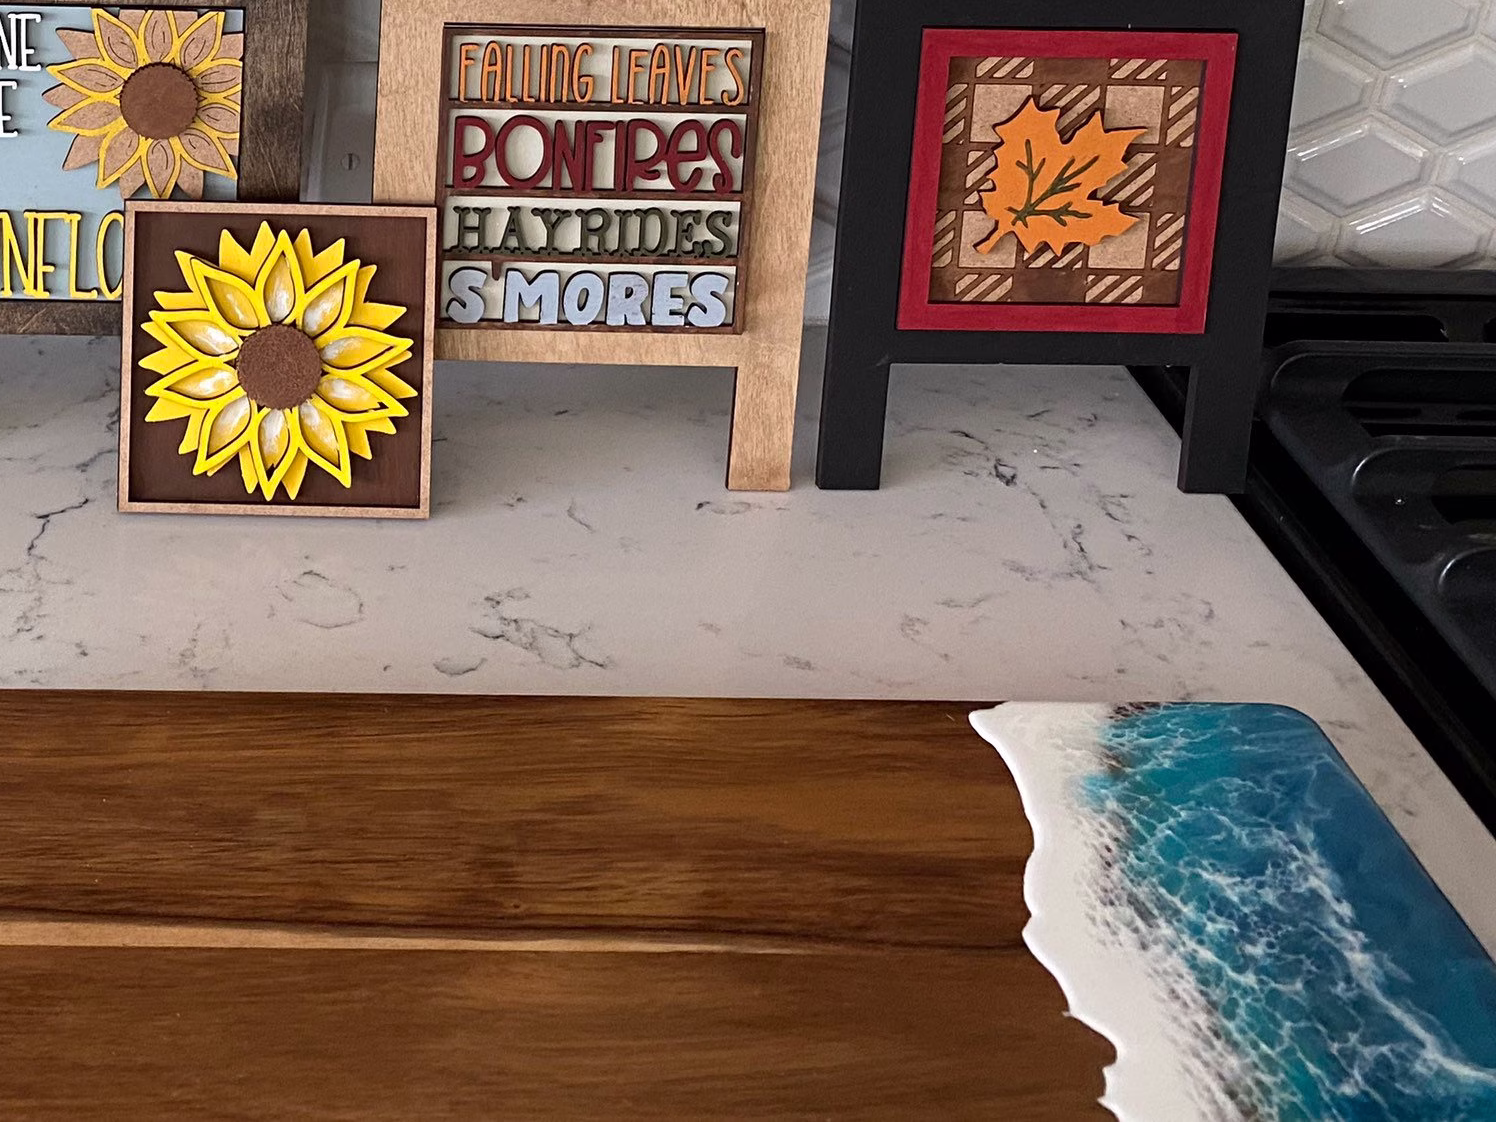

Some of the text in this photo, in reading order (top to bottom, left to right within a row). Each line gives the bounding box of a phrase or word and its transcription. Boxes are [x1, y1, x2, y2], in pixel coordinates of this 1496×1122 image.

[459, 41, 745, 106] FALLING LEAVES
[453, 206, 734, 258] HAYRIDES
[446, 266, 730, 327] S'MORES
